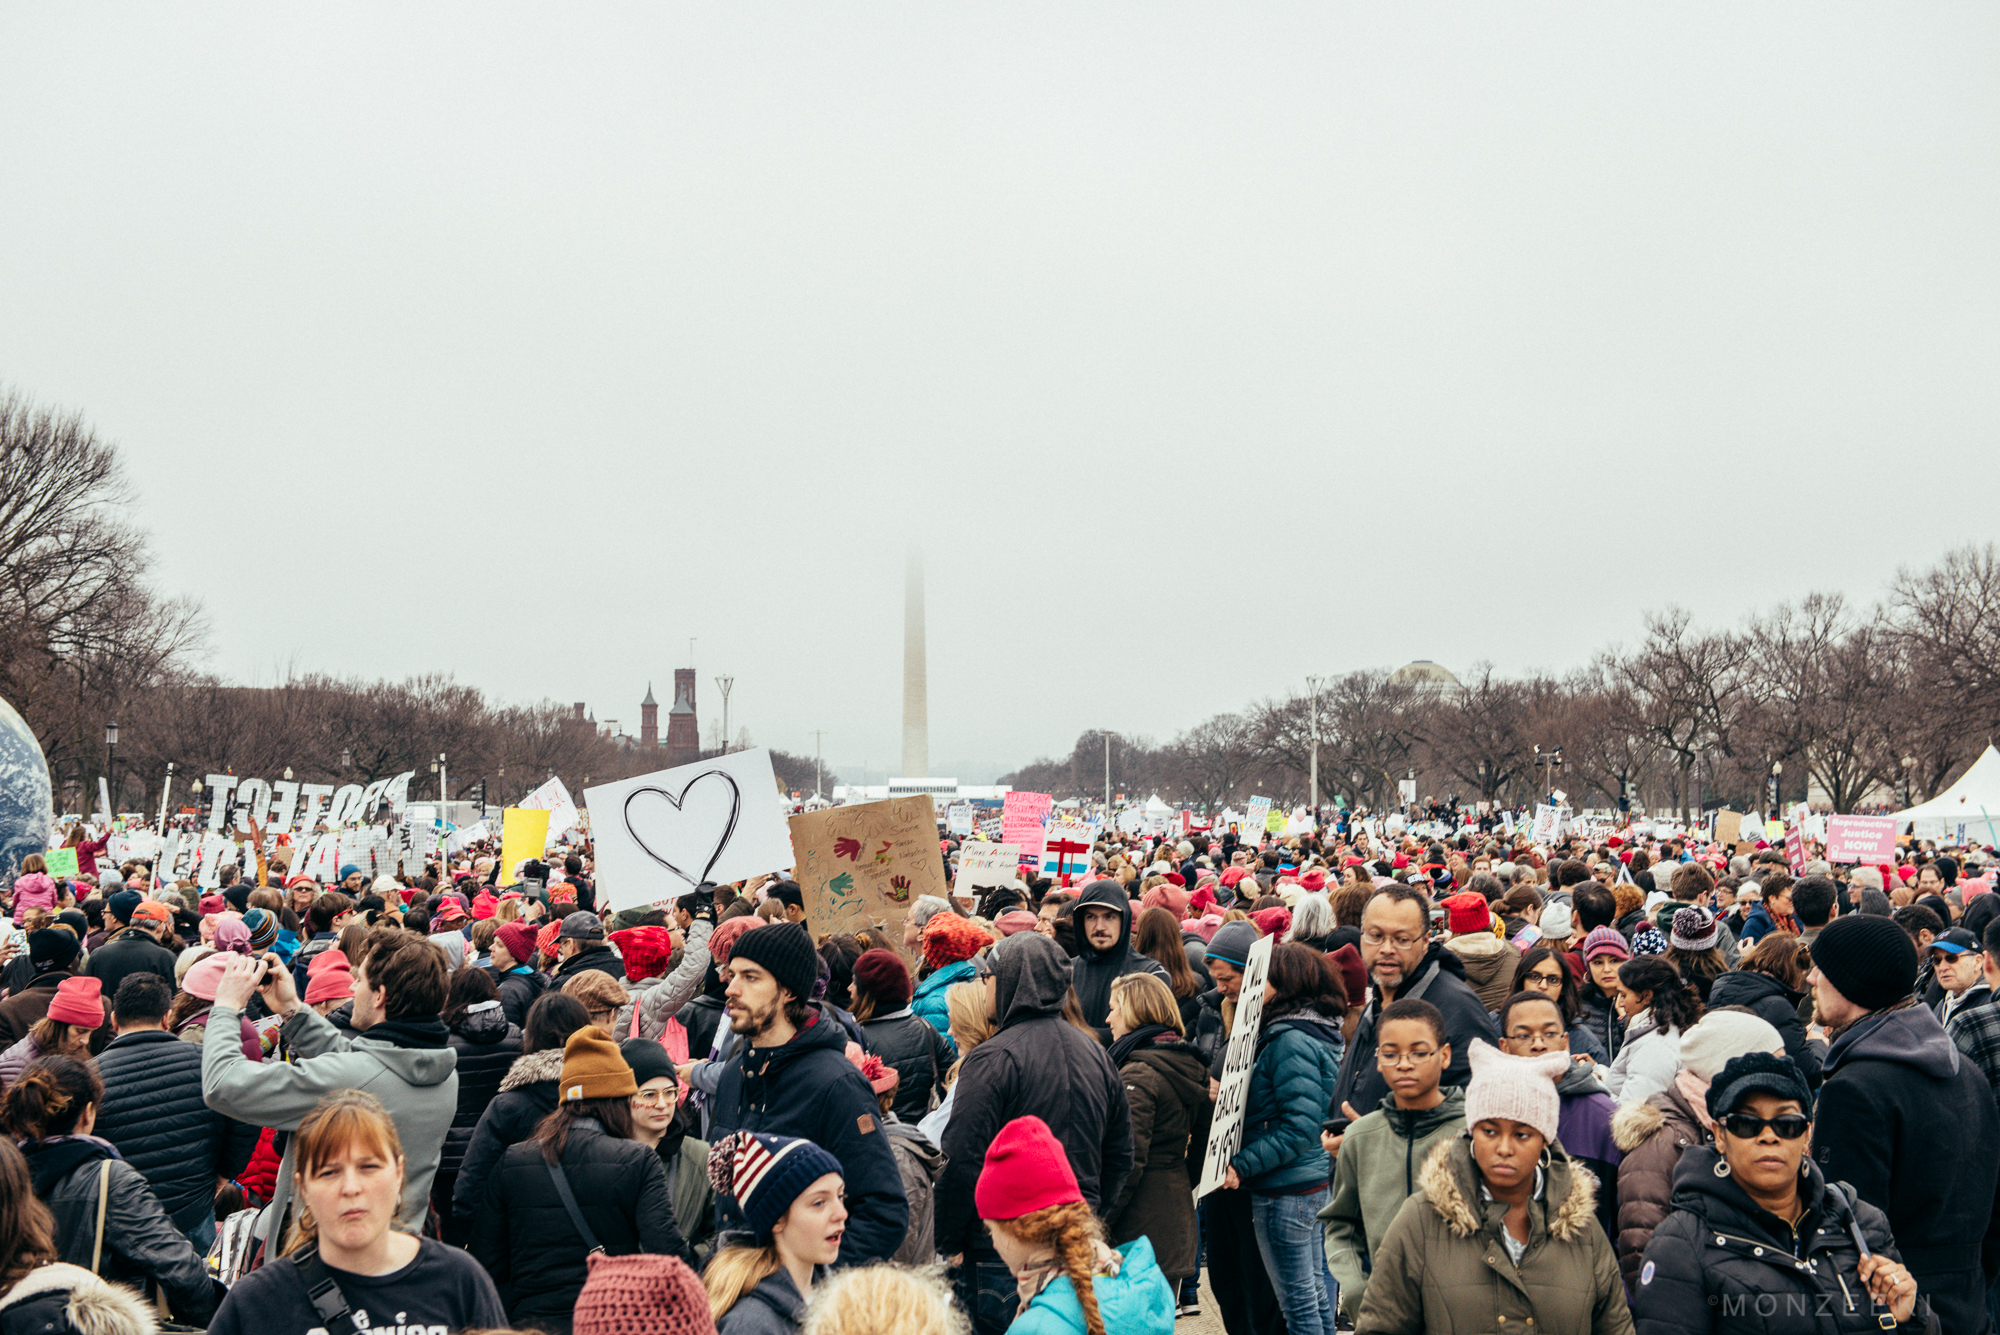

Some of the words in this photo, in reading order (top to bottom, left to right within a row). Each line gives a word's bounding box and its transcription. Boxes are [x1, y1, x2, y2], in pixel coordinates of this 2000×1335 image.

[1832, 818, 1893, 829] Reproductive
[1840, 829, 1883, 840] Justice
[1844, 840, 1878, 851] NOW!
[965, 859, 994, 869] THINK
[1225, 1028, 1259, 1077] QUIETLY
[1215, 1082, 1238, 1122] BACK
[1234, 1077, 1243, 1114] 2
[1208, 1135, 1220, 1159] THE
